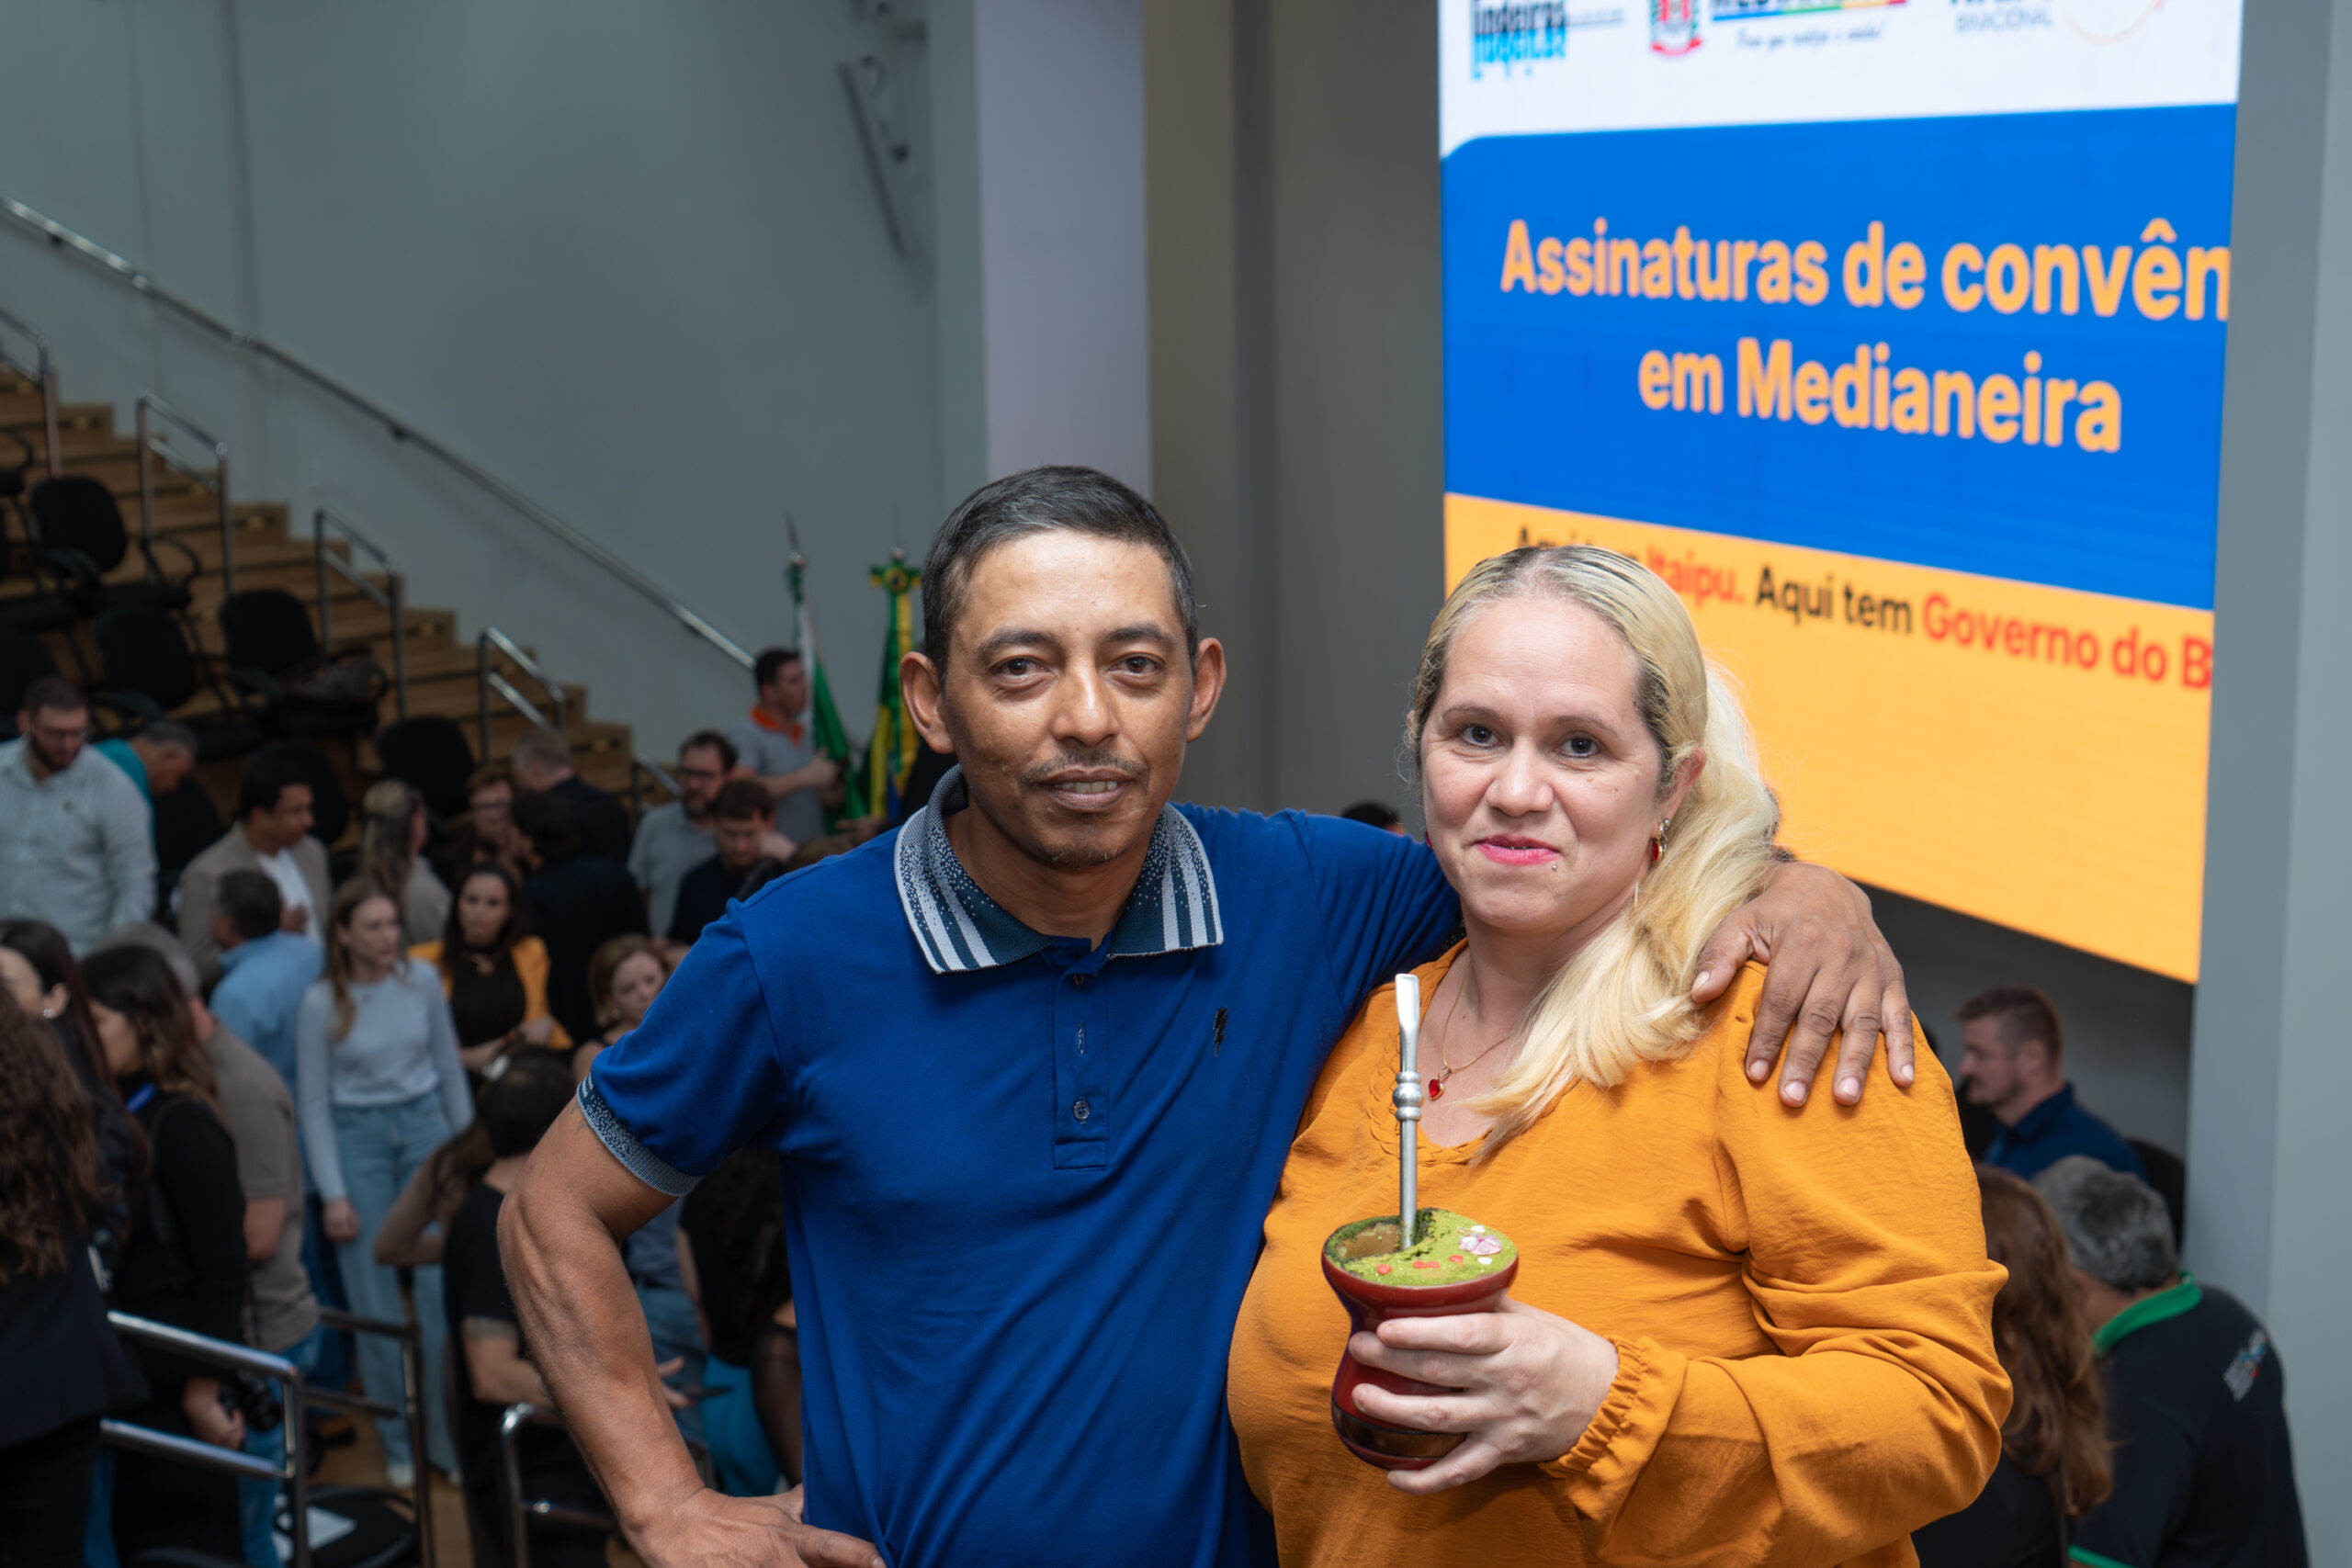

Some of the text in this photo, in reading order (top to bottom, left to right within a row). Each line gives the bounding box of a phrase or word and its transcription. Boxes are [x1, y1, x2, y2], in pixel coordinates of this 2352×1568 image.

[1499, 216, 2229, 323] Assinaturas de convên
[1637, 335, 2123, 454] em Medianeira
[1754, 563, 1835, 626] Aqui
[1842, 582, 1914, 636] tem
[1921, 592, 2101, 671] Governo
[2110, 625, 2169, 683] do
